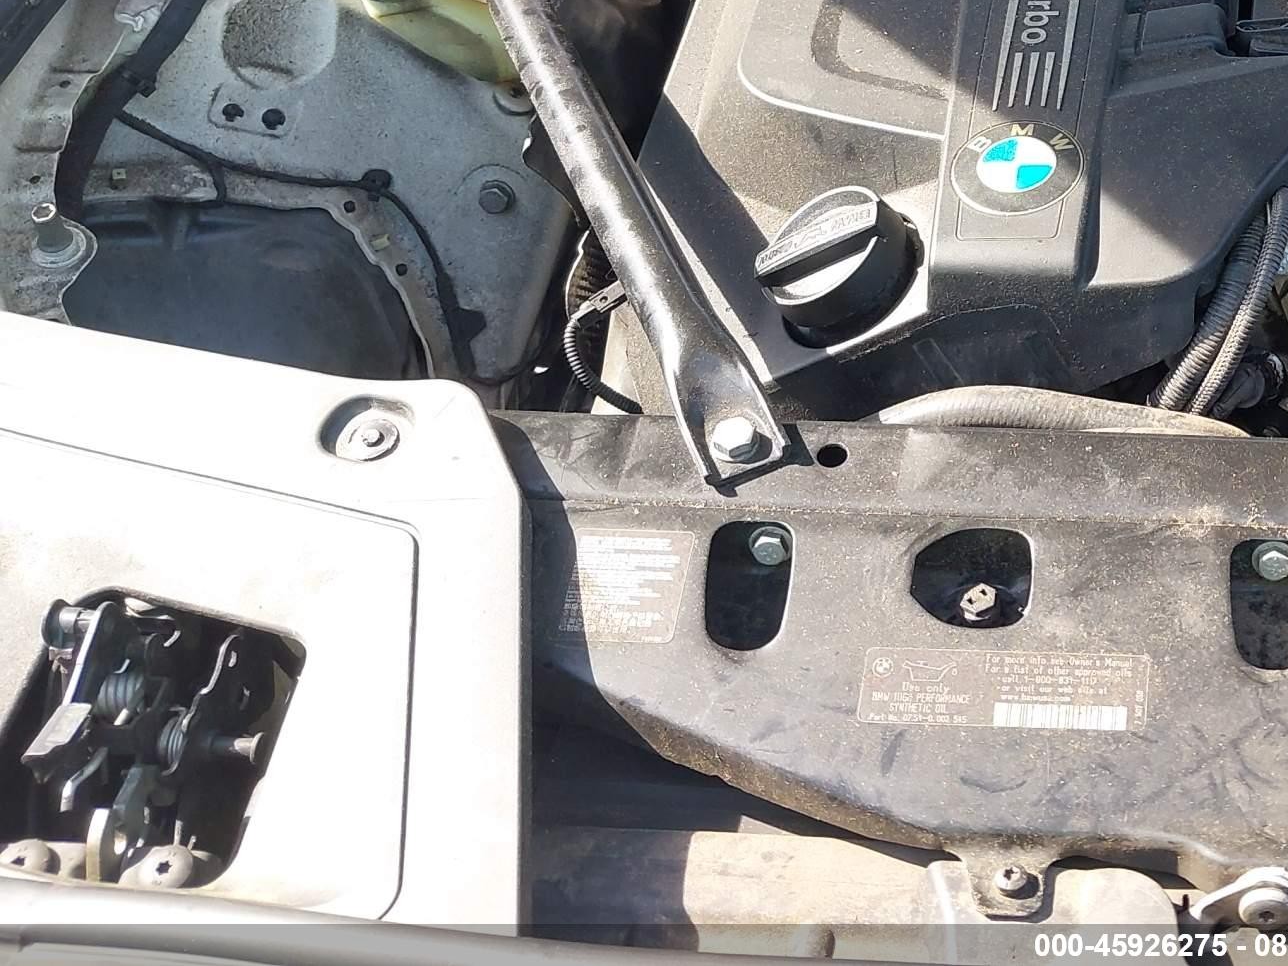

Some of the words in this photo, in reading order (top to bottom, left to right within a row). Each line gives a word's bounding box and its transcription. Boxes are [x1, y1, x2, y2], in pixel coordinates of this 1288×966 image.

[986, 653, 1001, 663] For
[1104, 657, 1132, 667] Manual
[985, 664, 1000, 673] For
[1034, 665, 1043, 675] of
[1048, 665, 1069, 675] other
[902, 682, 920, 692] Use
[926, 682, 950, 695] only
[916, 692, 971, 704] PERFORMANCE
[889, 703, 932, 713] SYNTHETIC
